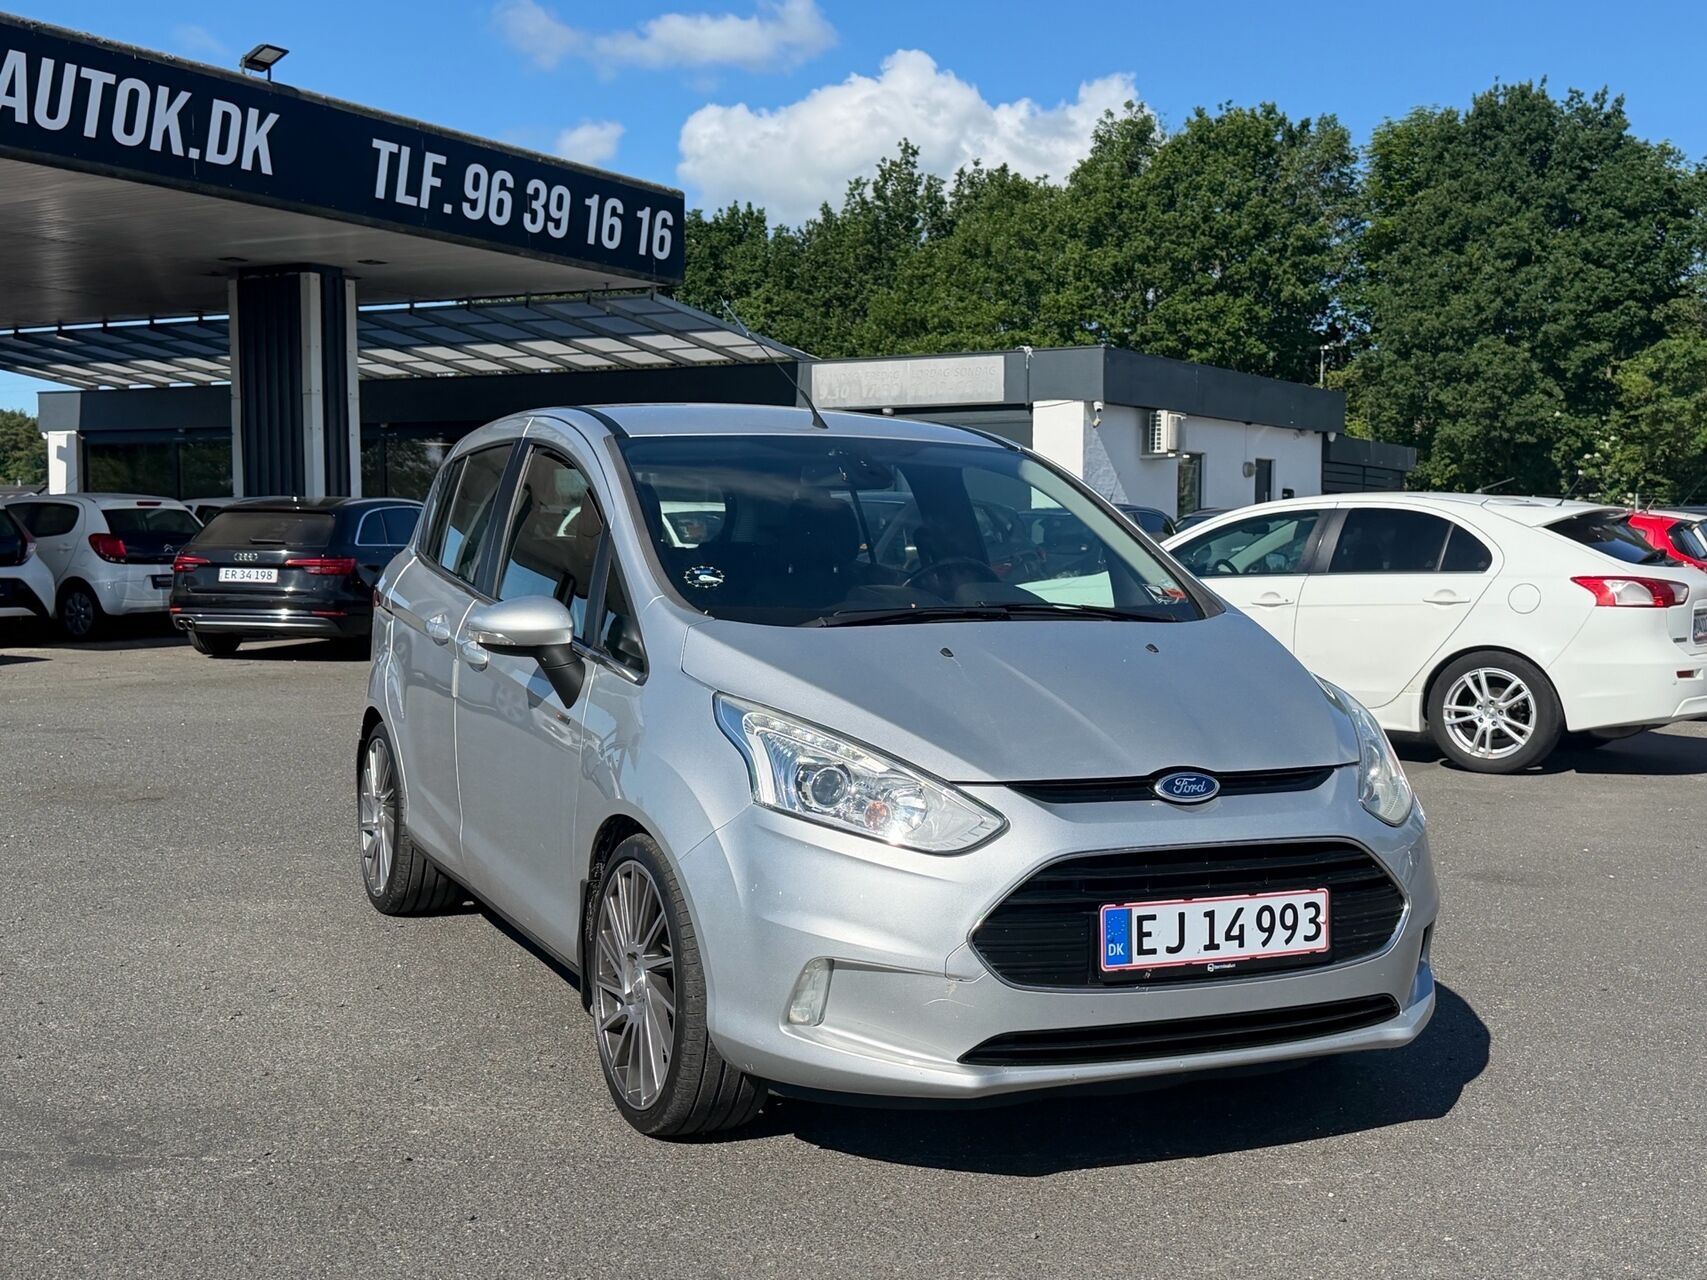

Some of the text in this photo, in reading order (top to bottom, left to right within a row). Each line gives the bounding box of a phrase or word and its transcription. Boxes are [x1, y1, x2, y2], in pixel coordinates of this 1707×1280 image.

[0, 49, 280, 177] AUTOK.DK
[371, 137, 674, 261] TLF. 96 39 16 16
[224, 569, 273, 581] ER 34 198
[1172, 777, 1207, 794] Ford
[1136, 901, 1322, 956] EJ 14 993
[1107, 942, 1125, 957] DK
